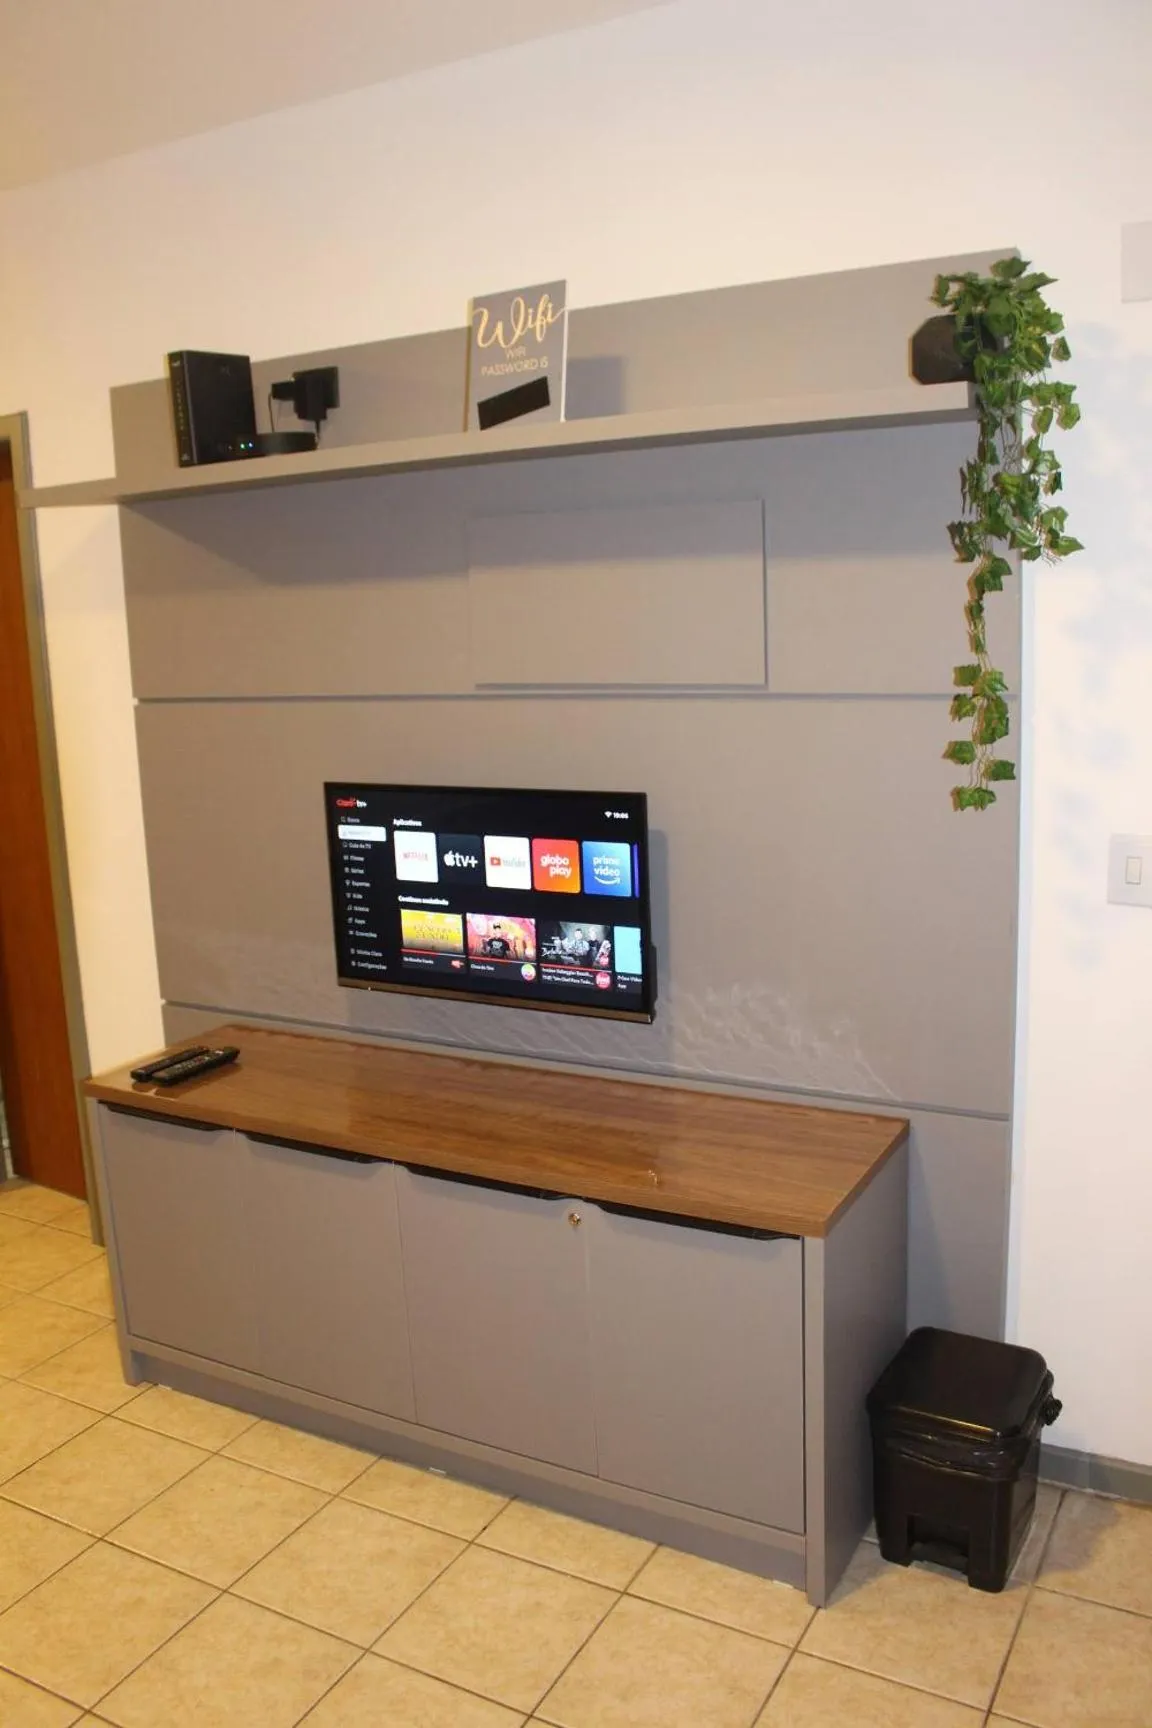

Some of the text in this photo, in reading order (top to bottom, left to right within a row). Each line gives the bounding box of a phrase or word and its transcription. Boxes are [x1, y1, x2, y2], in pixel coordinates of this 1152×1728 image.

[540, 854, 569, 866] globo
[592, 856, 620, 867] prime
[550, 865, 572, 877] play
[594, 866, 620, 876] video
